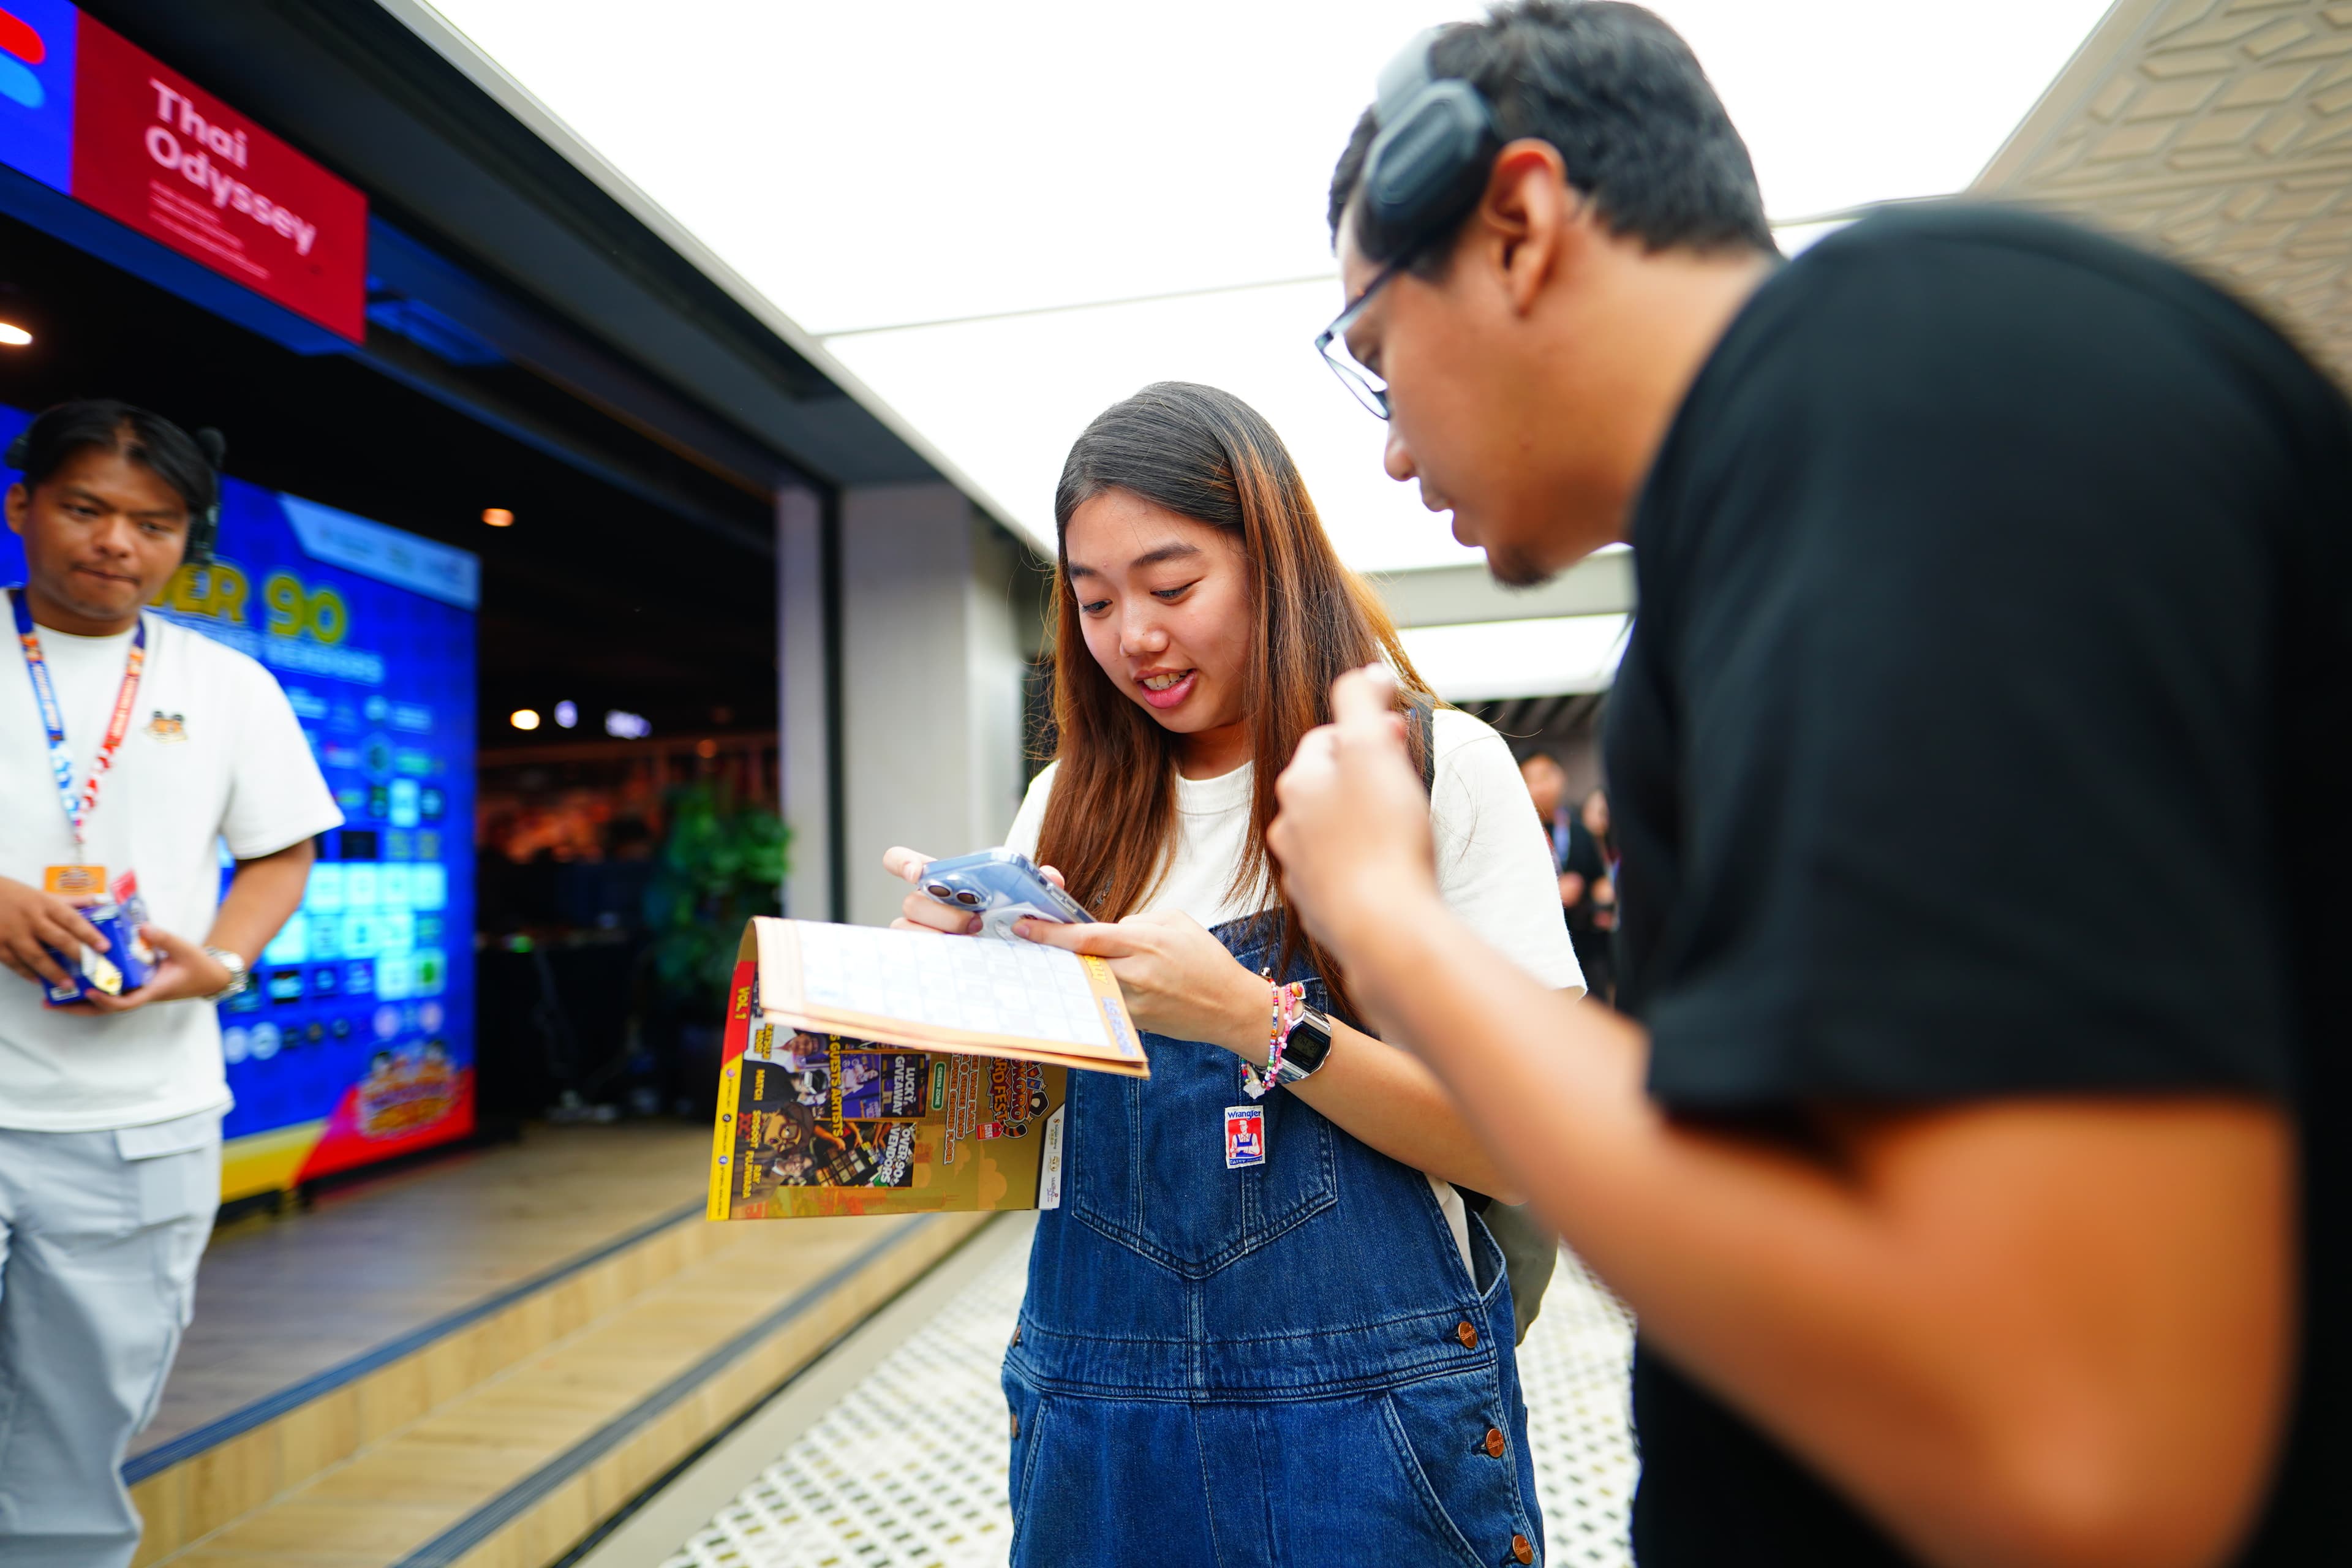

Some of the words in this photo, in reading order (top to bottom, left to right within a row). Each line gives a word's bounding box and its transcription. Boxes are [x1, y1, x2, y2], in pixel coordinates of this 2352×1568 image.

[148, 77, 248, 170] Thai
[145, 126, 317, 257] Odyssey
[148, 561, 248, 622] ER
[266, 576, 347, 644] 90
[1108, 1014, 1138, 1057] FLOOR
[829, 1042, 842, 1087] GUESTS
[950, 1056, 960, 1090] LOWER
[753, 1069, 765, 1101] MATCH
[892, 1055, 905, 1115] GIVEAWAY
[959, 1074, 968, 1107] SUNGEI
[969, 1071, 978, 1100] WANG
[831, 1088, 843, 1137] ARTISTS
[948, 1091, 958, 1129] GROUND
[967, 1101, 976, 1132] PLAZA
[993, 1085, 1008, 1123] FEST
[1227, 1110, 1261, 1120] Wrangler
[957, 1109, 966, 1138] WANG
[880, 1127, 900, 1184] VENDORS
[897, 1128, 912, 1160] OVER
[945, 1131, 955, 1162] FLOOR
[753, 1164, 762, 1184] RAY
[892, 1160, 906, 1185] 90+
